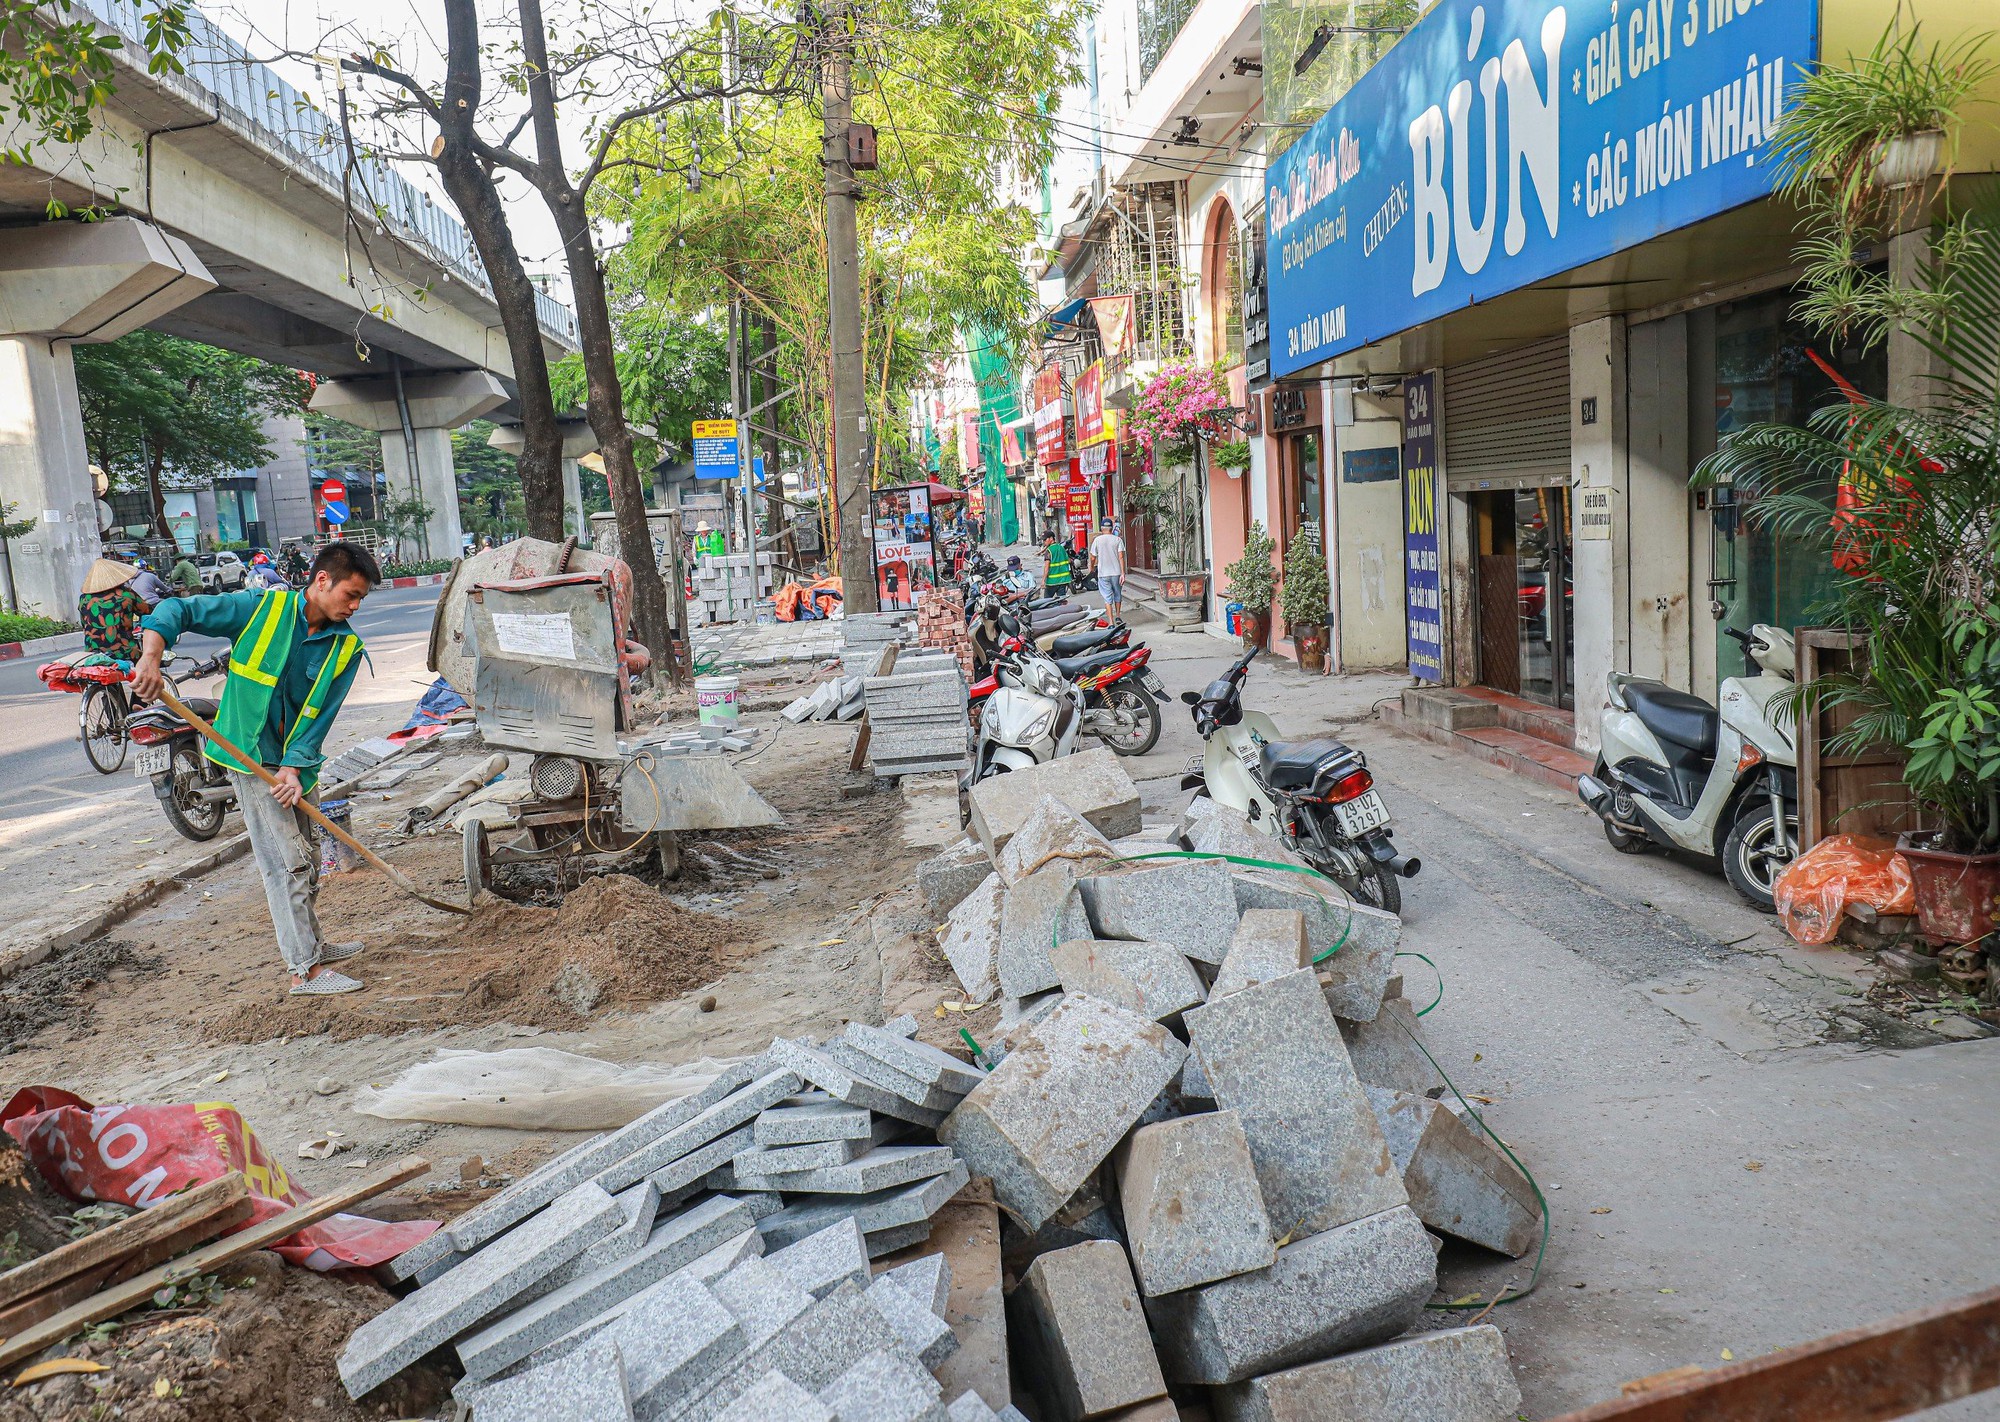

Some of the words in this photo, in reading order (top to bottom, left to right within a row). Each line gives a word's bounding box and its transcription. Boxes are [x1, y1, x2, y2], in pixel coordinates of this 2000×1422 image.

[1587, 1, 1621, 105] GIẢ
[1409, 6, 1566, 297] BÚN
[1587, 131, 1628, 218] CÁC
[1636, 99, 1692, 198] MÓN
[1701, 53, 1783, 169] NHẬU
[1314, 217, 1335, 252] Khiêm
[1363, 180, 1408, 257] CHUYÊN:
[1288, 327, 1299, 358] 34
[1301, 314, 1320, 353] HÀO
[1322, 305, 1346, 345] NAM
[1409, 384, 1428, 421] 34
[1583, 403, 1594, 421] 34
[1418, 423, 1432, 437] NAM
[1408, 447, 1434, 535] BÚN
[877, 546, 912, 560] LOVE
[1349, 808, 1382, 833] 3297
